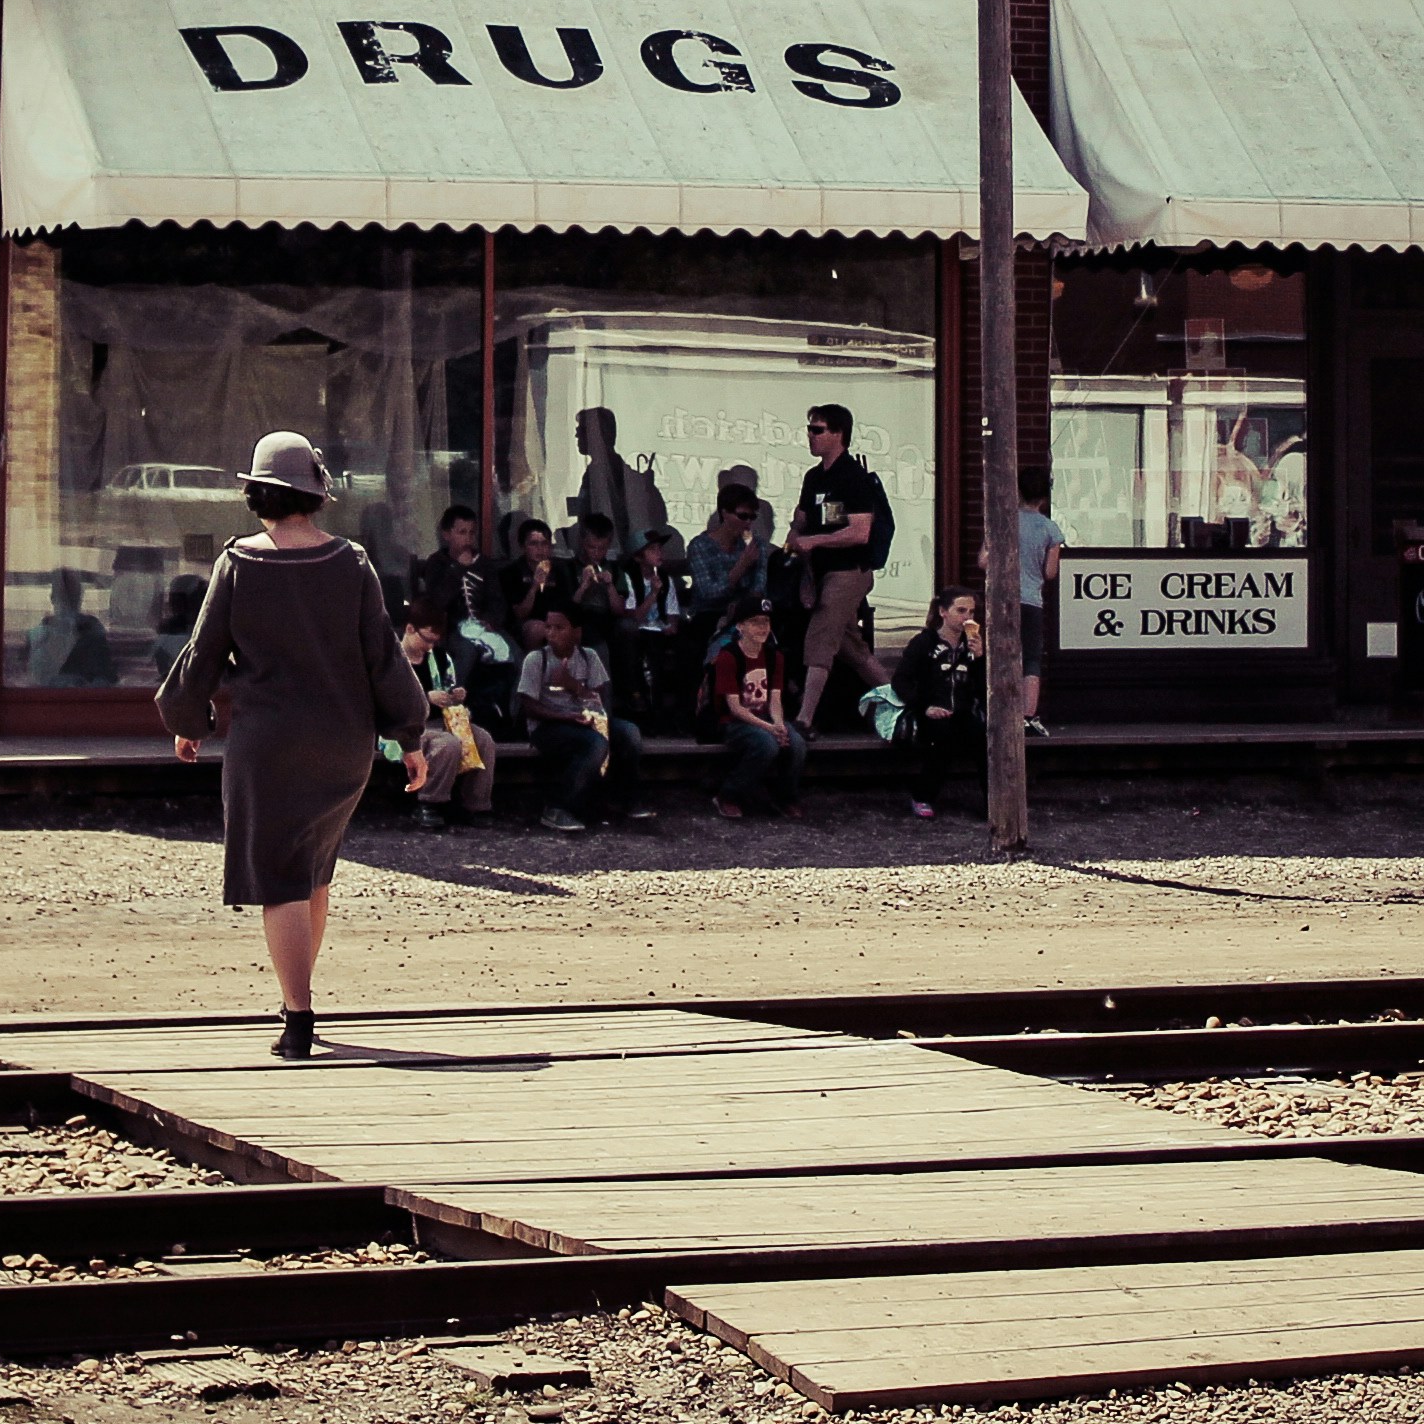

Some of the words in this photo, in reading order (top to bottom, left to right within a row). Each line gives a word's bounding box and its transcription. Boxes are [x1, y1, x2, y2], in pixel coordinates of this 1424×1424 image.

[178, 20, 902, 110] DRUGS
[1073, 573, 1133, 601] ICE
[1160, 572, 1295, 600] CREAM
[1094, 608, 1124, 638] &
[1140, 606, 1278, 636] DRINKS
